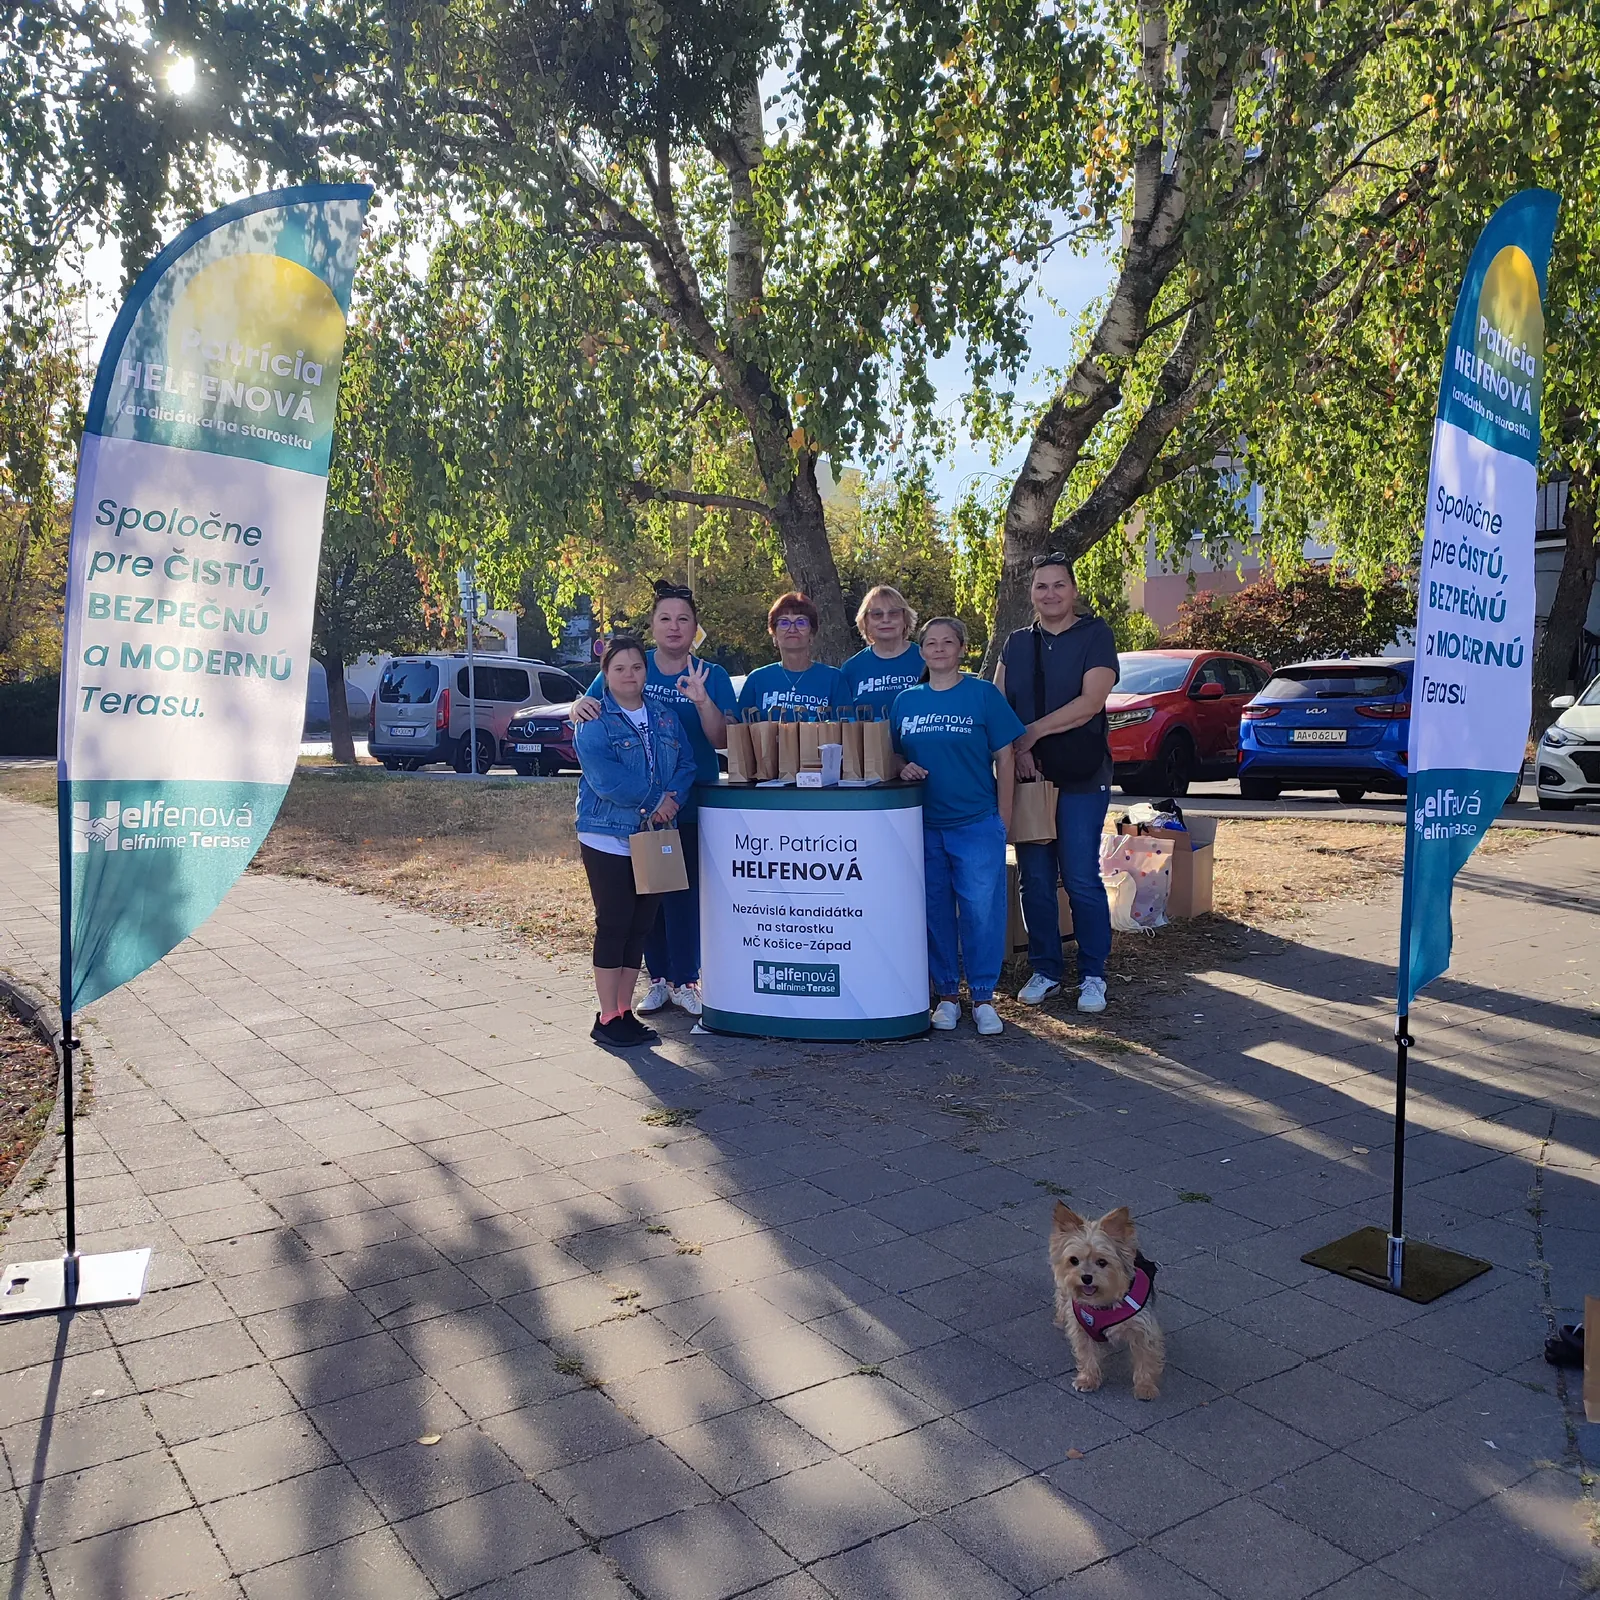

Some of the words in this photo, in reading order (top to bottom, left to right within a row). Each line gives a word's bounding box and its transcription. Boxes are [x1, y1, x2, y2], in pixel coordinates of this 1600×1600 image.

[181, 327, 323, 386] Patrícia
[1478, 315, 1535, 378] Patrícia
[119, 358, 315, 424] HELFENOVÁ
[1455, 345, 1532, 415] HELFENOVÁ
[216, 419, 237, 433] na
[241, 423, 312, 450] starostku
[1494, 415, 1531, 440] starostku
[95, 499, 262, 546] Spoločne
[1436, 485, 1502, 535] Spoločne
[87, 550, 154, 581] pre
[163, 547, 271, 596] ČISTÚ,
[1430, 538, 1456, 569] pre
[1458, 534, 1509, 584] ČISTÚ,
[88, 592, 269, 635] BEZPEČNÚ
[1429, 580, 1507, 623] BEZPEČNÚ
[1425, 633, 1435, 656] a
[83, 644, 109, 667] a
[120, 641, 292, 680] MODERNÚ
[857, 674, 919, 696] Helfenov
[81, 686, 204, 718] Terasu.
[945, 724, 972, 734] Terase
[189, 831, 251, 848] Terase
[735, 834, 774, 856] Mgr.
[780, 835, 858, 852] Patrícia
[732, 857, 863, 881] HELFENOVÁ
[732, 903, 786, 916] Nezávislá
[789, 906, 863, 918] kandidátka
[757, 922, 772, 932] na
[775, 923, 834, 934] starostku
[743, 935, 761, 947] MČ
[763, 938, 851, 953] Košice-Západ
[806, 984, 836, 993] Terase
